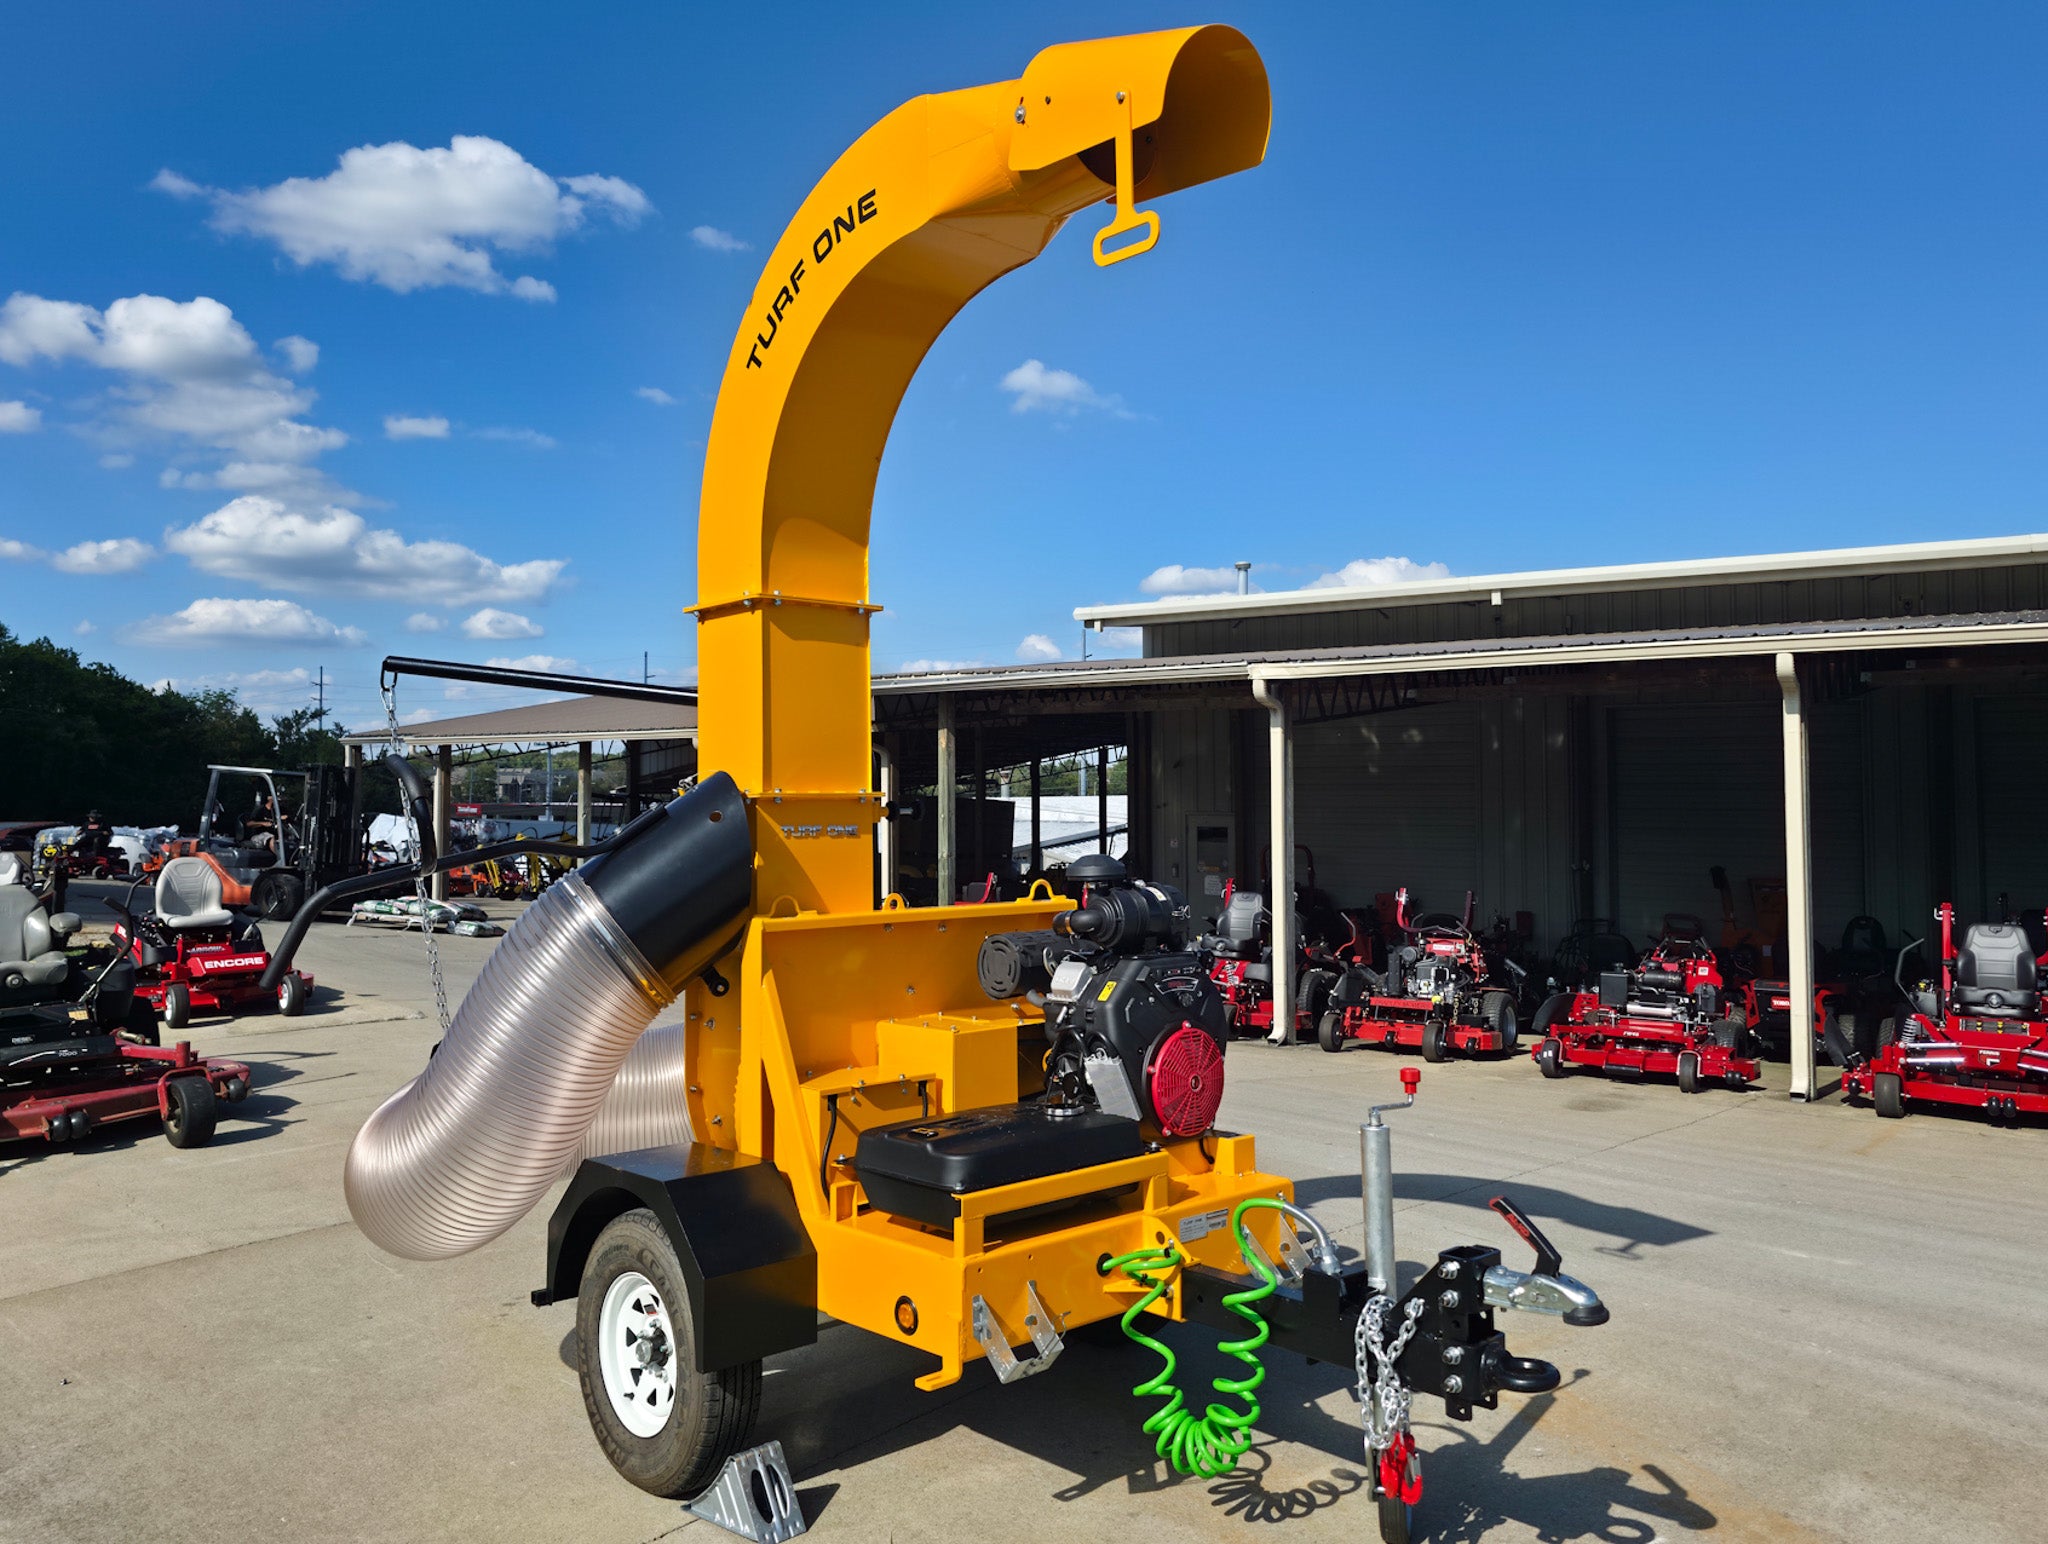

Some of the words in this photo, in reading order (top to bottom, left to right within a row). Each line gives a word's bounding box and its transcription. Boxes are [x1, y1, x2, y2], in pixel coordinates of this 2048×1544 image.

[746, 259, 805, 369] TURF
[813, 188, 877, 264] ONE
[781, 825, 821, 836] TURF
[827, 825, 858, 836] ONE
[204, 957, 264, 969] ENCORE
